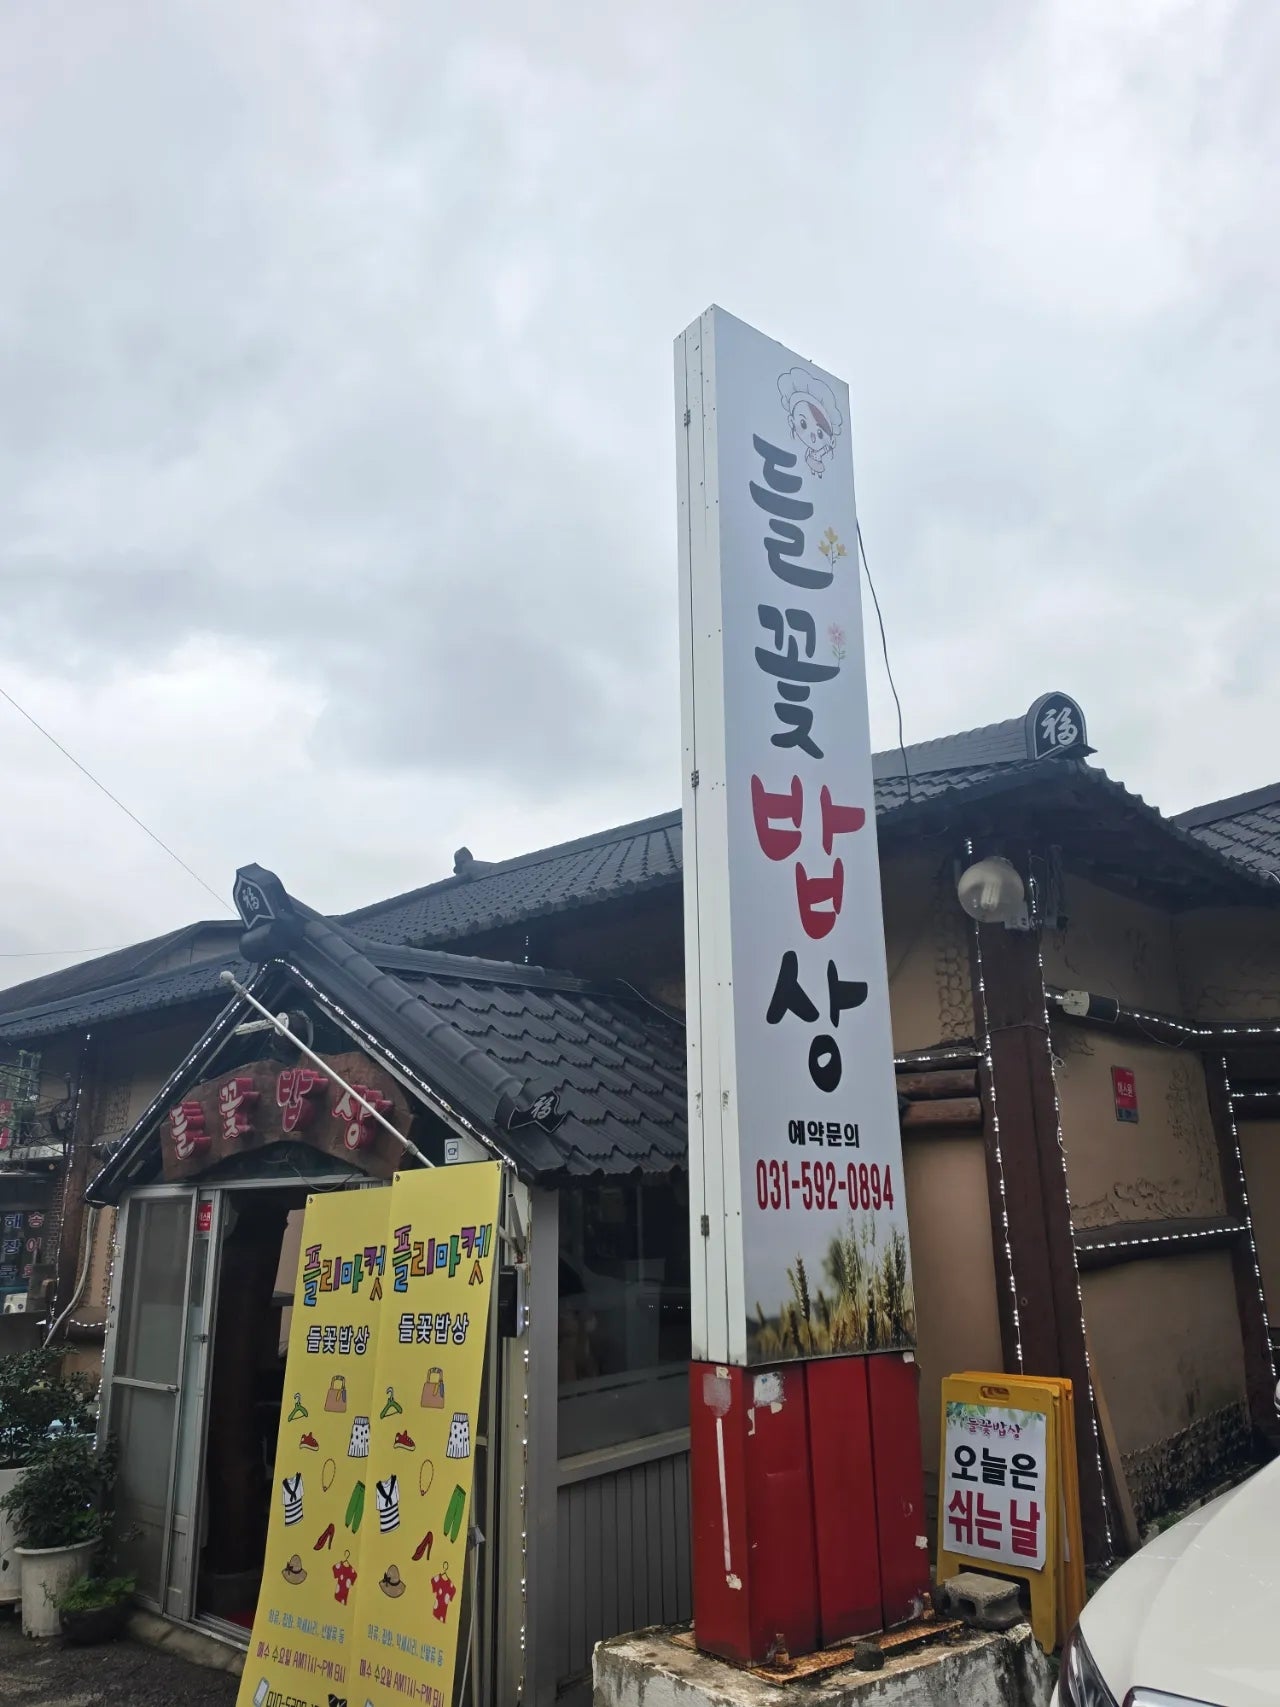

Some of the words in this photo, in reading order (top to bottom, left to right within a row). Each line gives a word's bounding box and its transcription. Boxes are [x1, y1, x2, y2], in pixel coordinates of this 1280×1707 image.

[749, 433, 868, 1093] 들꽃밥상
[788, 1119, 860, 1148] 예약문의
[756, 1158, 894, 1211] 031-592-0894
[391, 1223, 493, 1294] 플리마켓
[306, 1325, 370, 1355] 들꽃밥상
[398, 1312, 470, 1345] 들꽃밥상
[967, 1417, 1023, 1440] 들꽃밥상
[951, 1445, 1038, 1491] 오늘은
[949, 1490, 1002, 1550] 쉬는
[1010, 1499, 1040, 1558] 날
